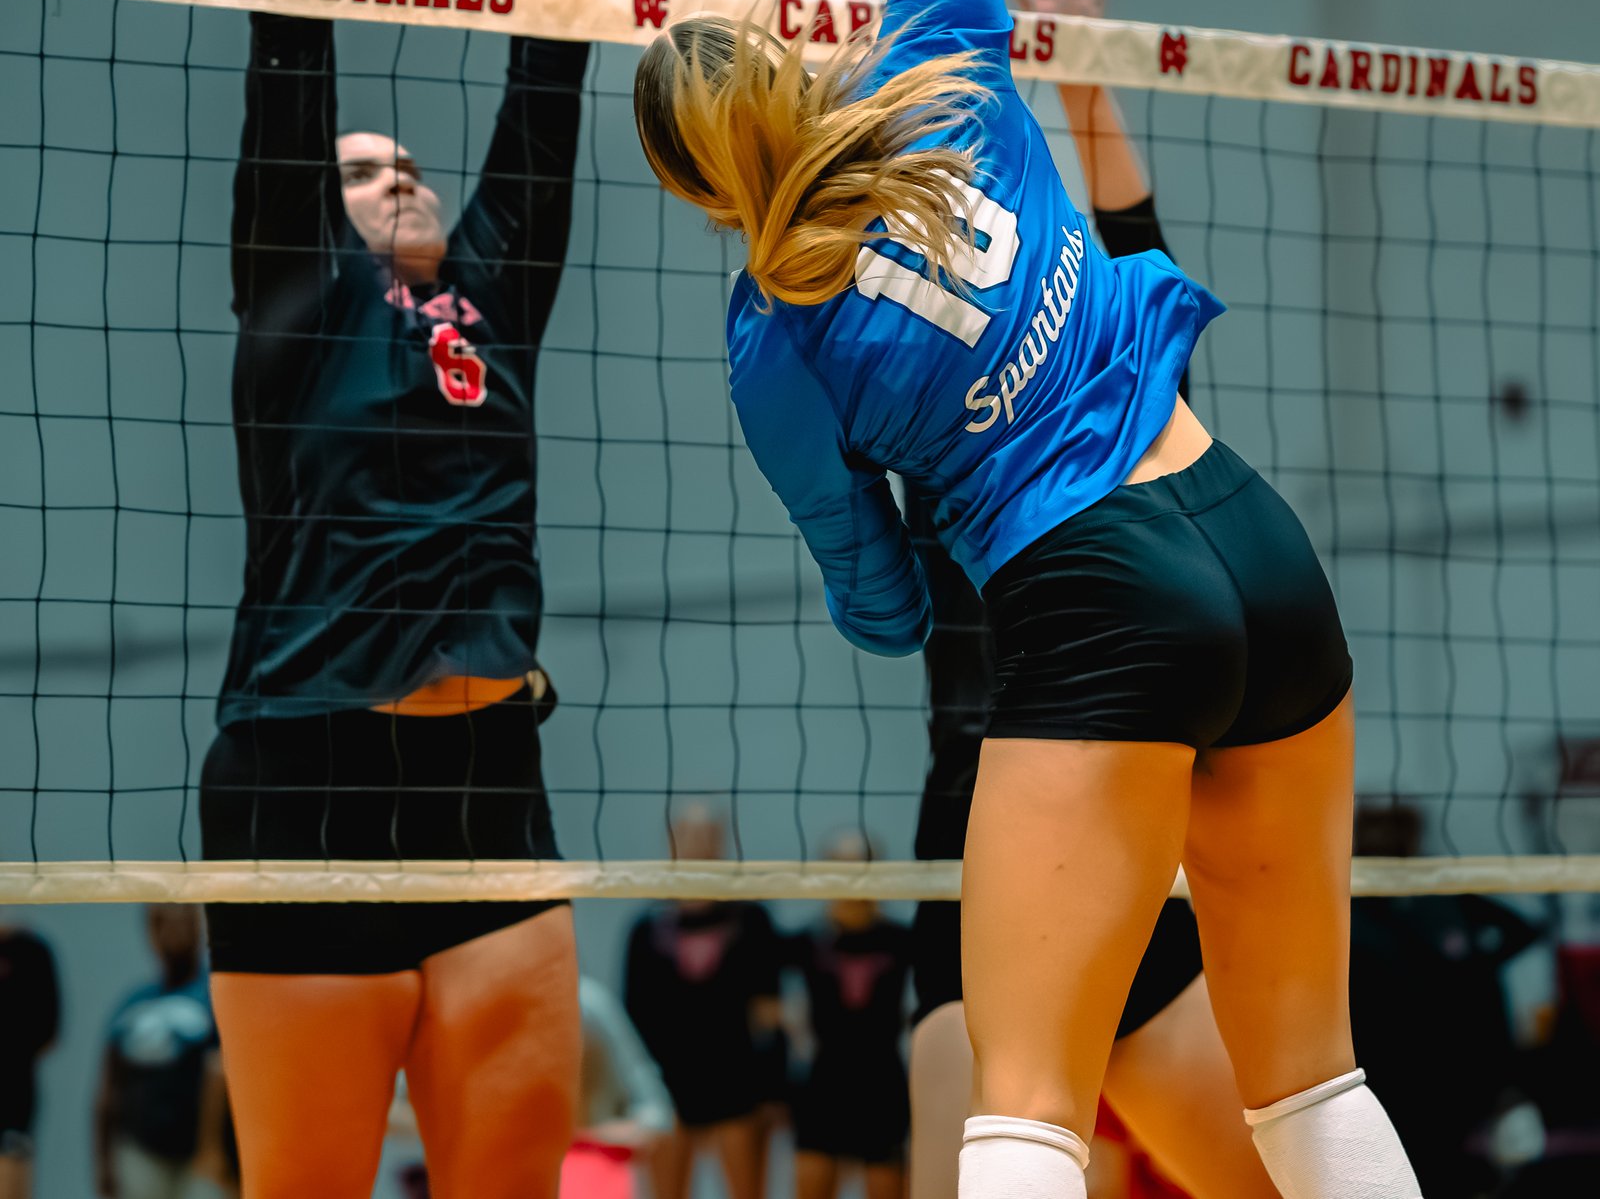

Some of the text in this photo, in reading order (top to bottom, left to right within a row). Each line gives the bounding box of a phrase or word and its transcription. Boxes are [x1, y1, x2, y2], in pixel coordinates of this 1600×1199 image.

[1287, 43, 1538, 105] CARDINALS
[854, 166, 1021, 350] 10
[428, 322, 488, 408] 6
[964, 225, 1084, 434] Spartans
